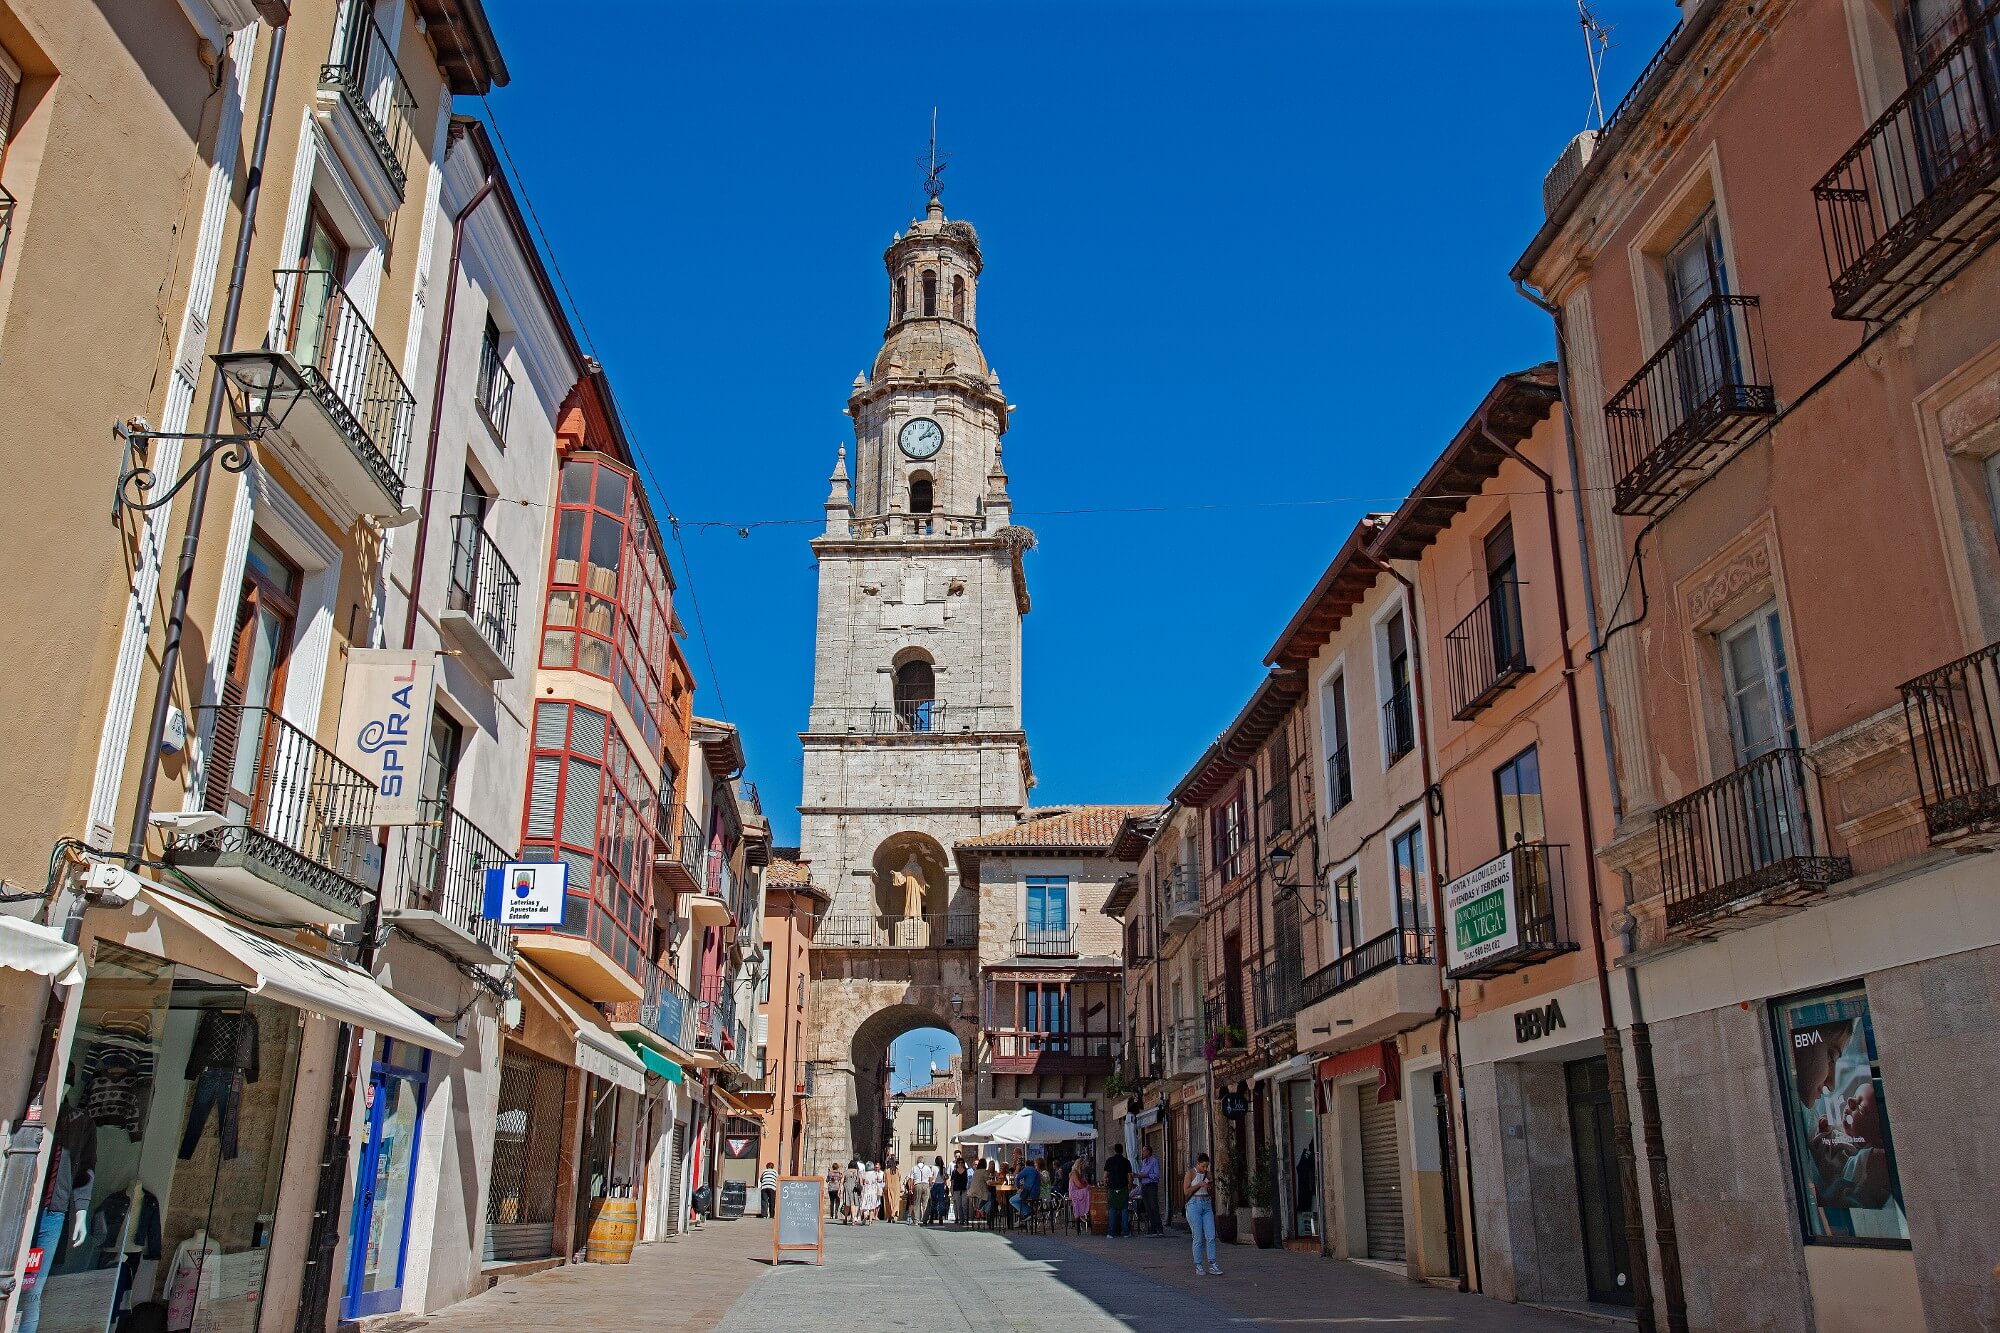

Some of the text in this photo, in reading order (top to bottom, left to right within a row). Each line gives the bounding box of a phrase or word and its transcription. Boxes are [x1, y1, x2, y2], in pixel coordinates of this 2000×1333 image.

[372, 659, 417, 797] SPIRAL
[1448, 872, 1510, 909] VIVIENDAS Y TERRENOS
[1451, 859, 1507, 894] VENTA Y ALQUILER DE
[1456, 894, 1503, 925] INMOBILIARIA
[1473, 911, 1502, 939] VEGA
[1514, 998, 1567, 1043] BBVA
[1794, 1029, 1823, 1048] BBVA
